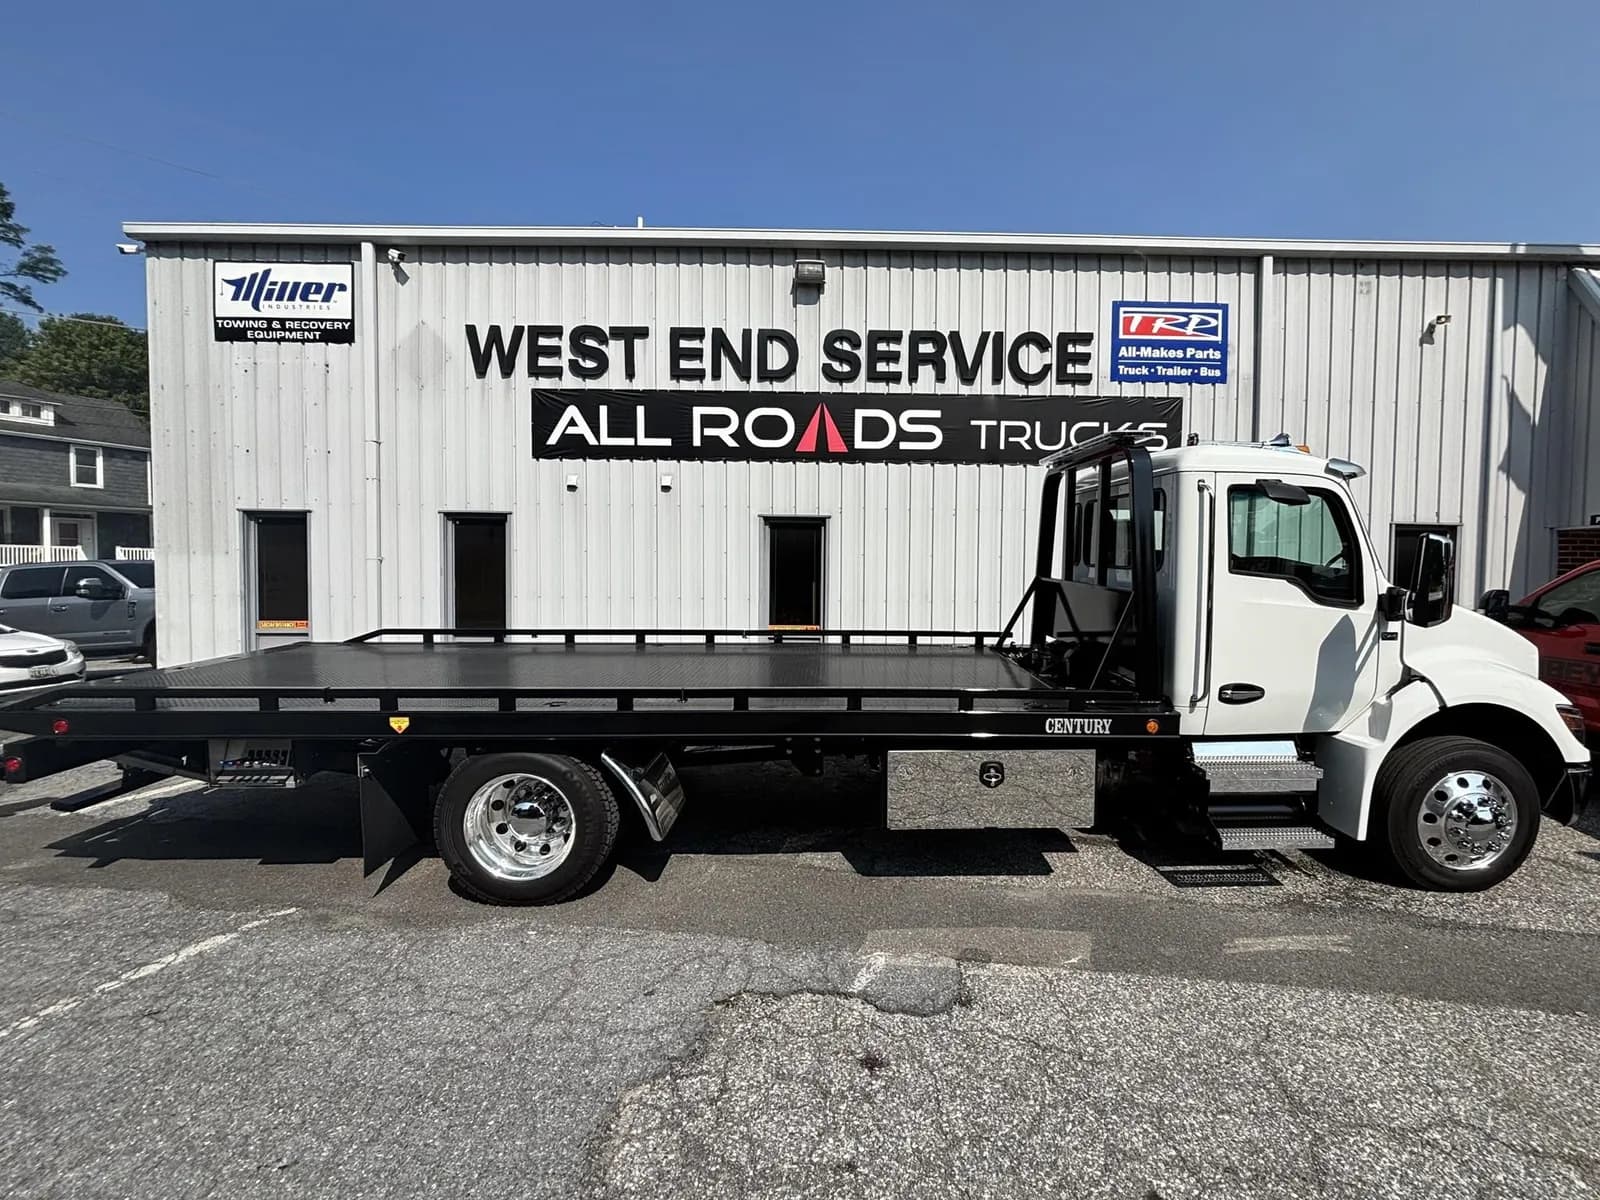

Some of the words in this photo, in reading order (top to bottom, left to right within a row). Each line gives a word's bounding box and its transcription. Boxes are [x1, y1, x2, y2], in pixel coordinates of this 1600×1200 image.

[222, 268, 347, 312] Miller
[262, 303, 331, 311] INDUSTRIES
[216, 319, 267, 329] TOWING
[271, 321, 281, 329] &
[285, 321, 351, 330] RECOVERY
[1122, 313, 1220, 337] TRP
[247, 330, 321, 340] EQUIPMENT
[465, 324, 649, 381] WEST
[669, 326, 800, 383] END
[821, 329, 1094, 385] SERVICE
[1118, 346, 1184, 358] All-Makes
[1186, 347, 1221, 359] Parts
[1118, 365, 1149, 375] Truck
[1156, 366, 1192, 376] Trailer
[1200, 367, 1221, 377] Bus
[545, 404, 672, 447] ALL
[1045, 718, 1112, 734] CENTURY
